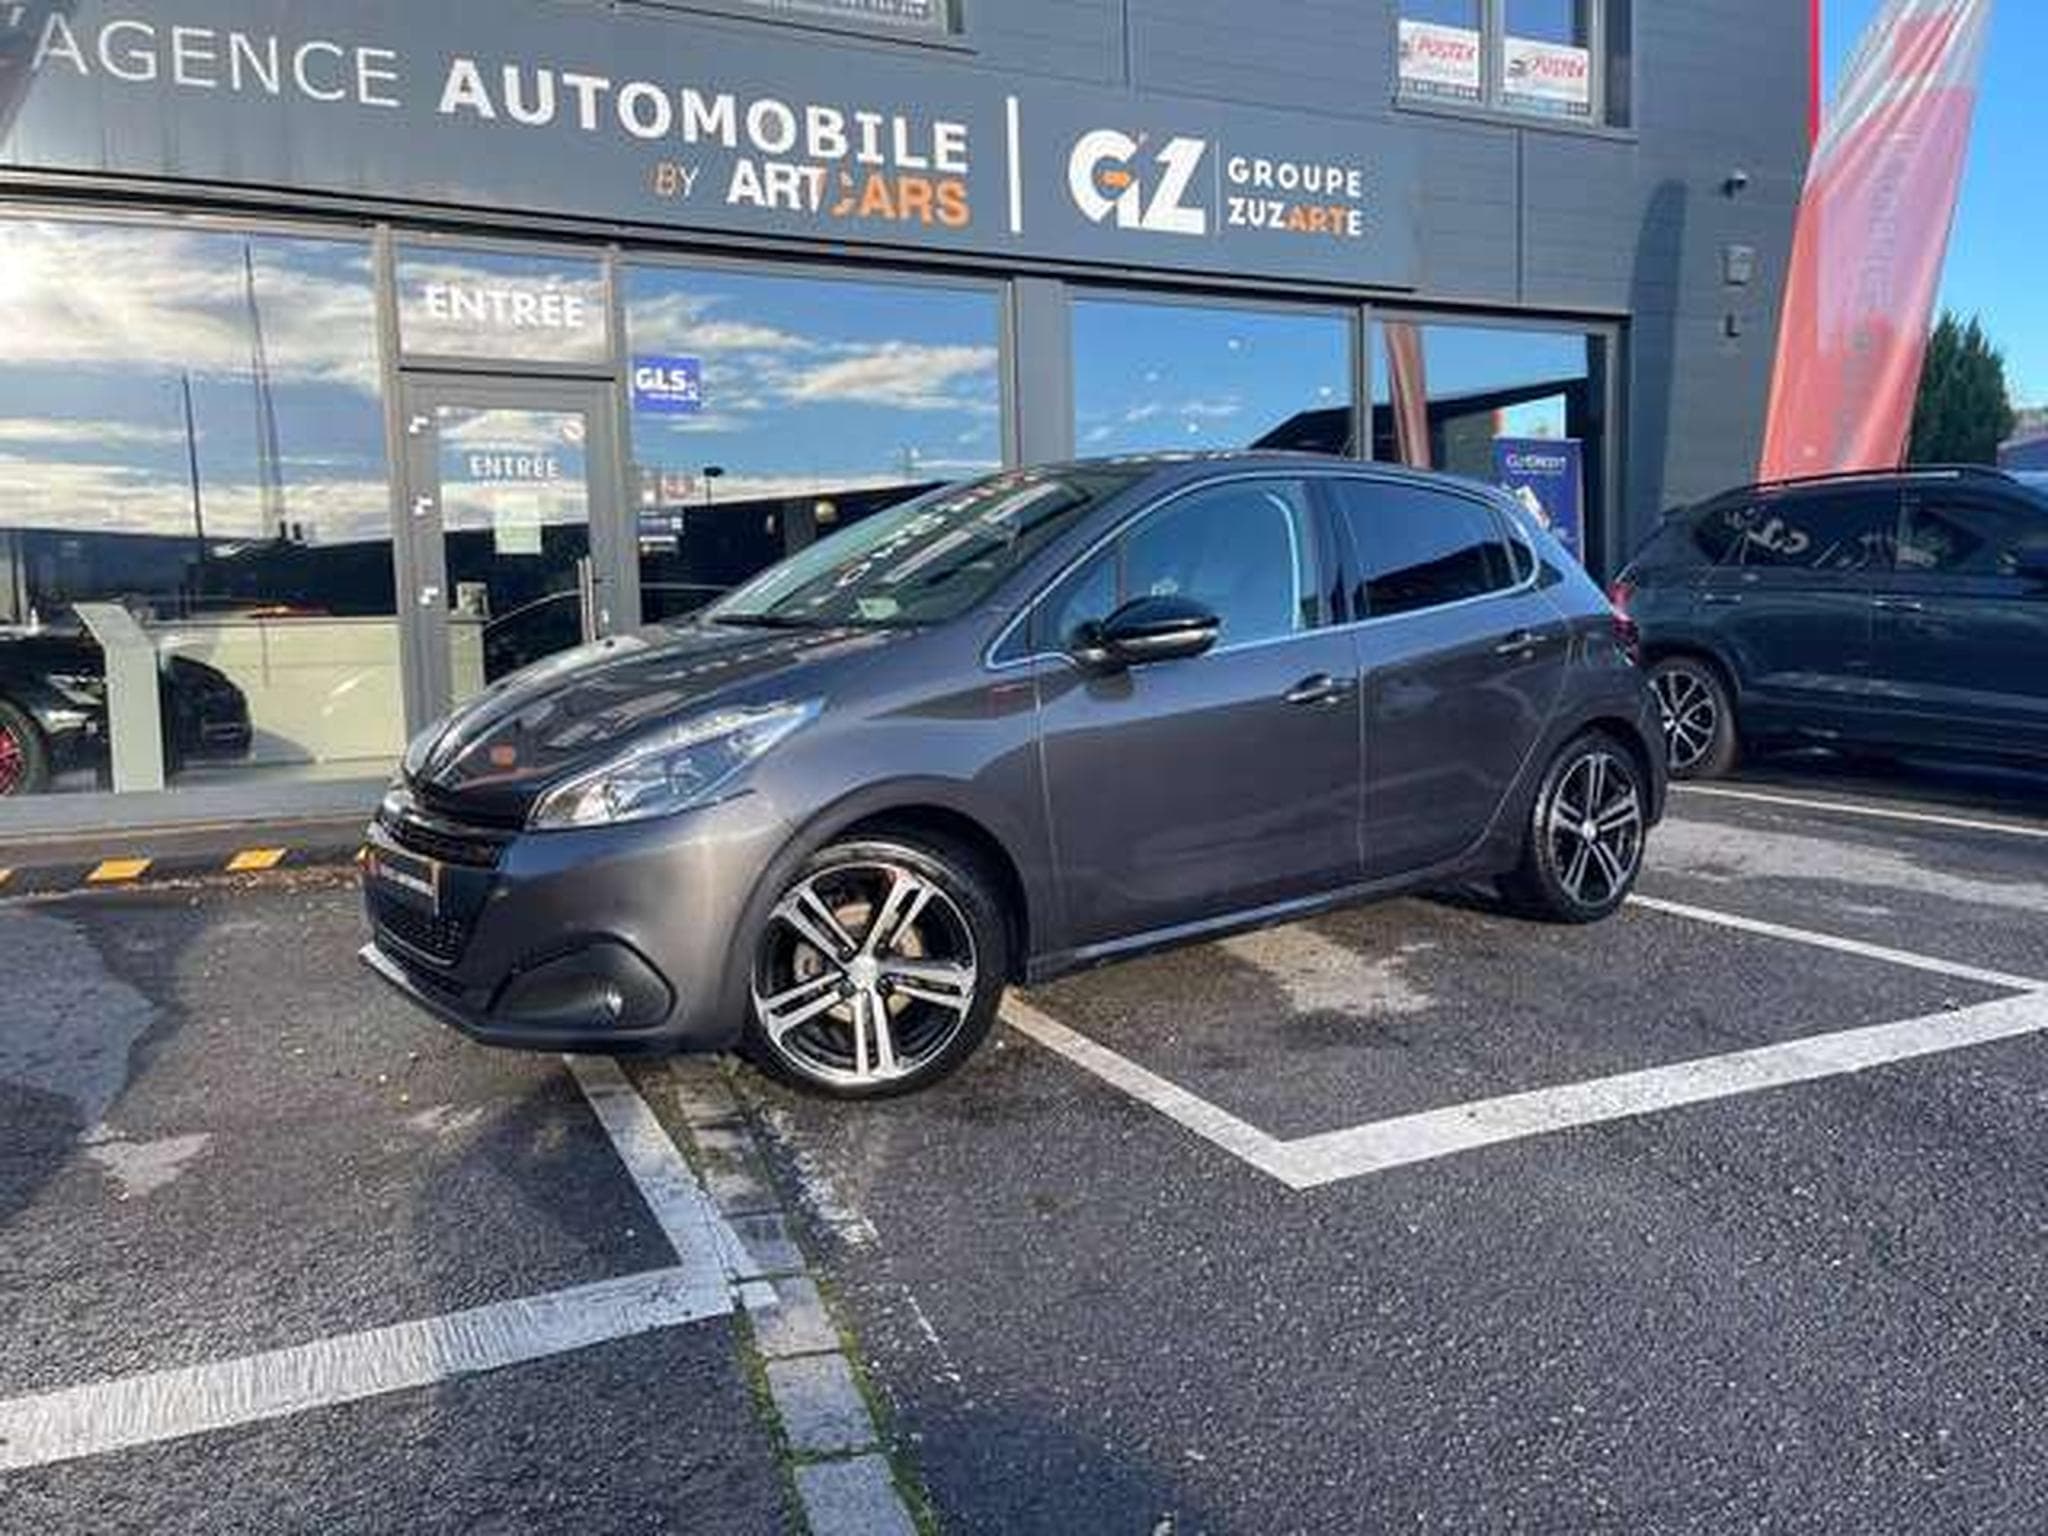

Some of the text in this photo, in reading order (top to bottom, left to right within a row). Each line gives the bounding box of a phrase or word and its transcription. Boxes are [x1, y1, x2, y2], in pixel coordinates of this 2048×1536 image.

[438, 58, 969, 174] AUTOMOBILE
[655, 163, 699, 197] BY
[1227, 156, 1363, 199] GROUPE
[1227, 197, 1363, 237] ZUZARTE
[423, 275, 585, 329] ENTRÉE
[636, 367, 687, 391] GLS
